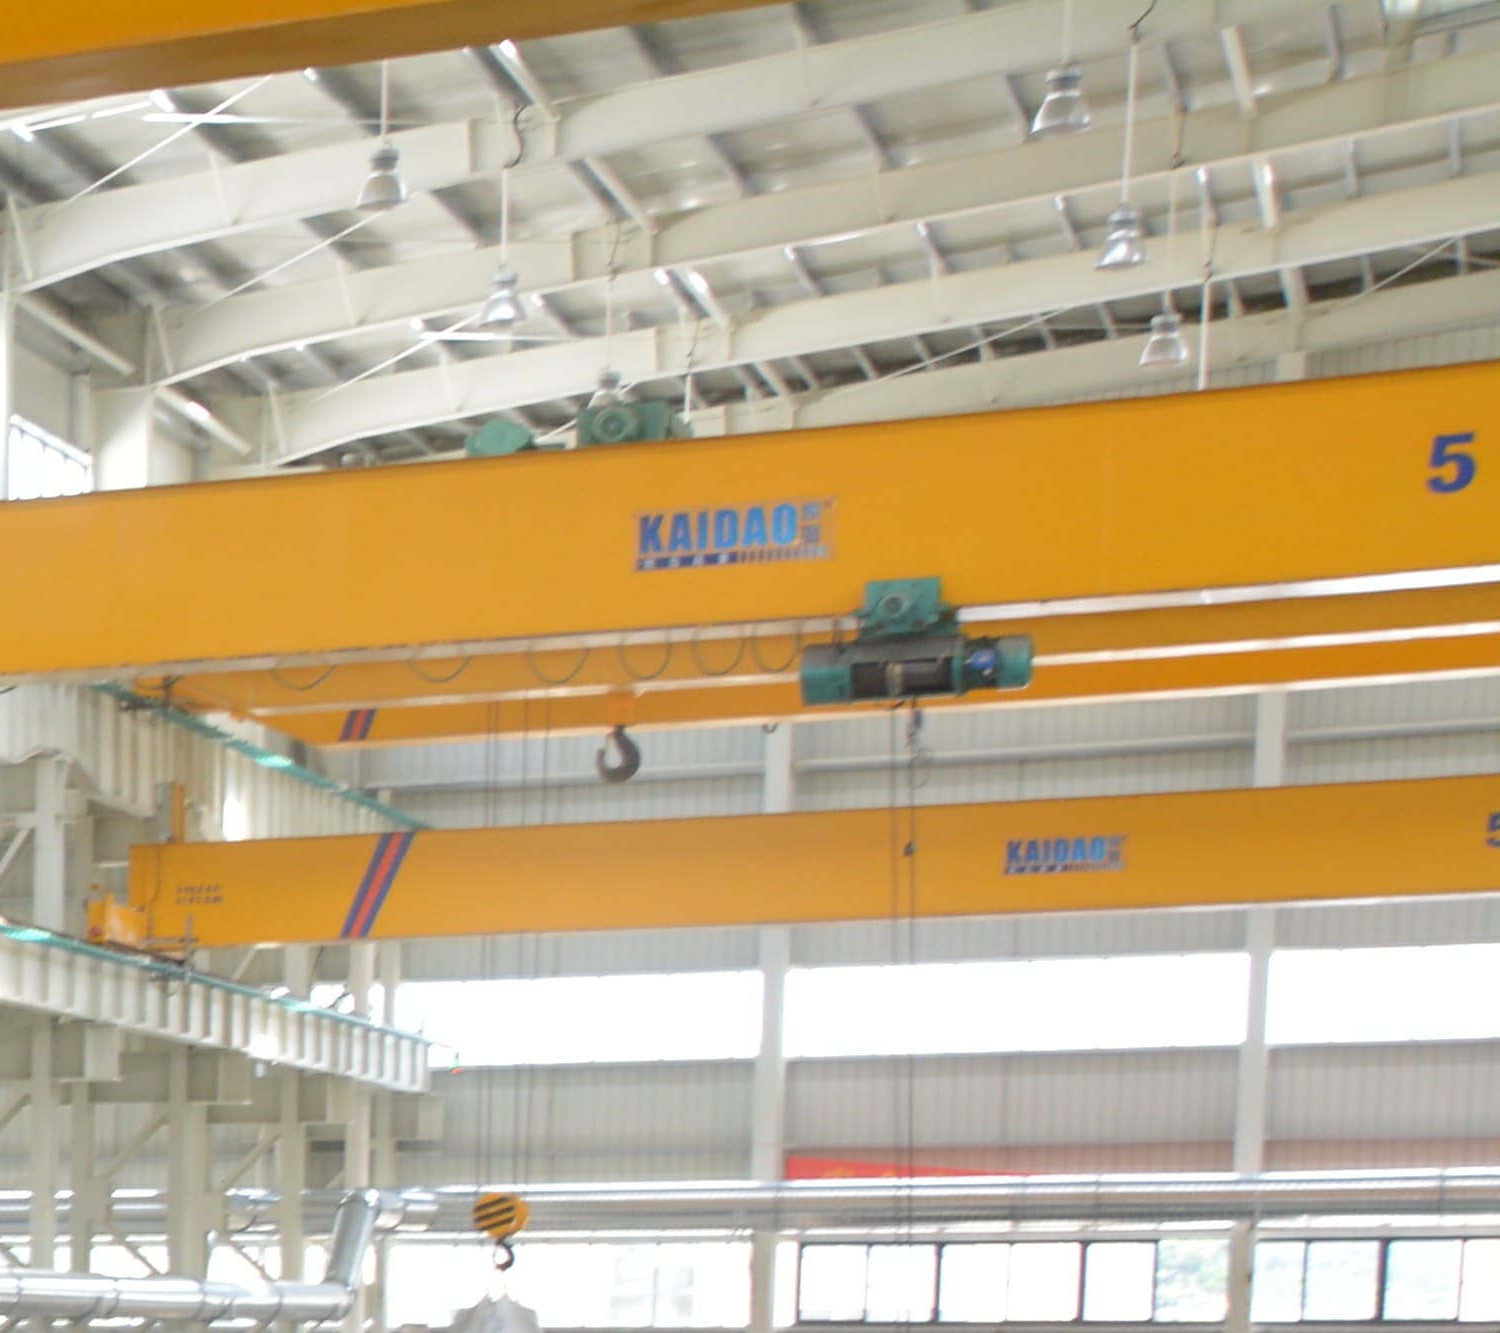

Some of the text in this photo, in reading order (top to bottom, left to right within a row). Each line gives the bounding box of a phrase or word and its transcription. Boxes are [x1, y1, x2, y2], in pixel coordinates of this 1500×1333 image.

[1426, 431, 1477, 495] 5
[638, 502, 798, 556] KAIDAO
[1006, 835, 1107, 864] KAIDAO
